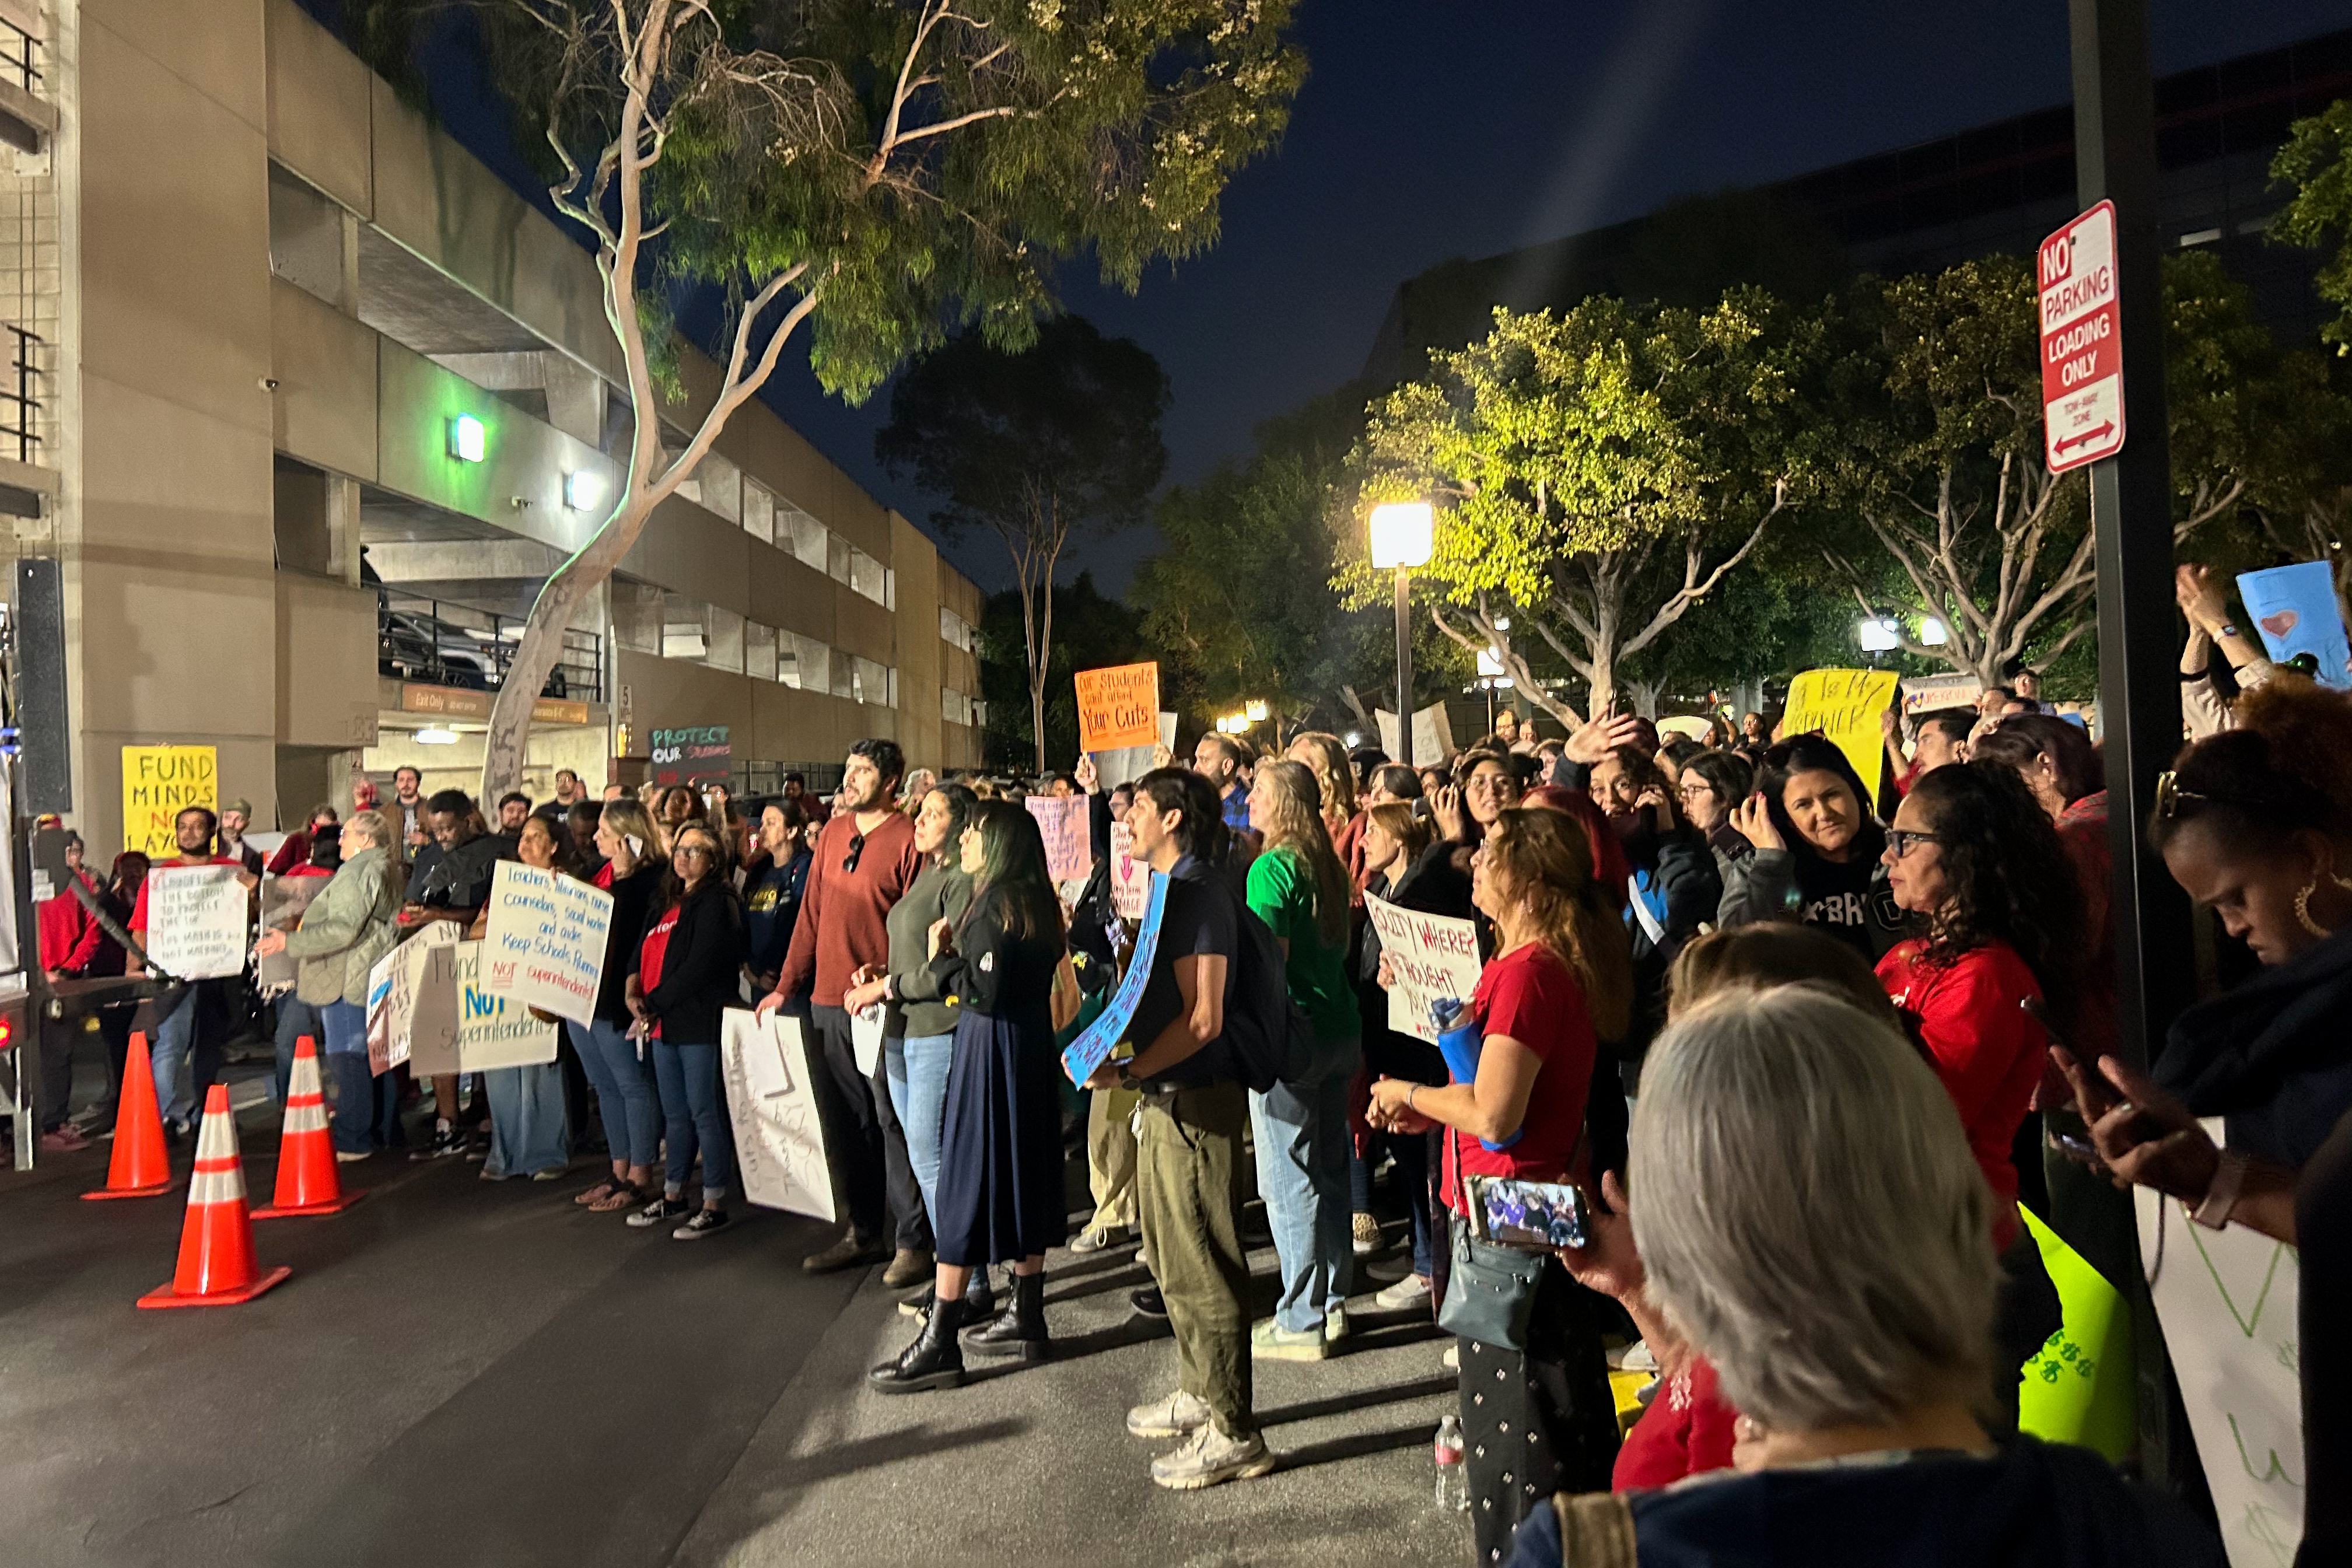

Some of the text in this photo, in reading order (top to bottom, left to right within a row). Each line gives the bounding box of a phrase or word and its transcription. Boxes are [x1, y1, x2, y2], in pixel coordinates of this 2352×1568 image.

[2043, 236, 2070, 285] NO
[2046, 265, 2109, 326] PARKING
[2049, 313, 2110, 363] LOADING
[2062, 351, 2097, 387] ONLY
[416, 692, 429, 706] Exit
[430, 694, 444, 711] Only
[623, 685, 629, 706] 5
[1083, 702, 1149, 737] Your Cuts
[653, 726, 729, 748] PROTECT
[140, 755, 213, 781] FUND
[652, 747, 682, 764] OUR
[133, 786, 214, 807] MINDS
[539, 921, 557, 936] and
[1416, 918, 1475, 958] WHERE?
[502, 932, 531, 956] Keep
[533, 936, 571, 964] Schools
[493, 960, 517, 979] NOT
